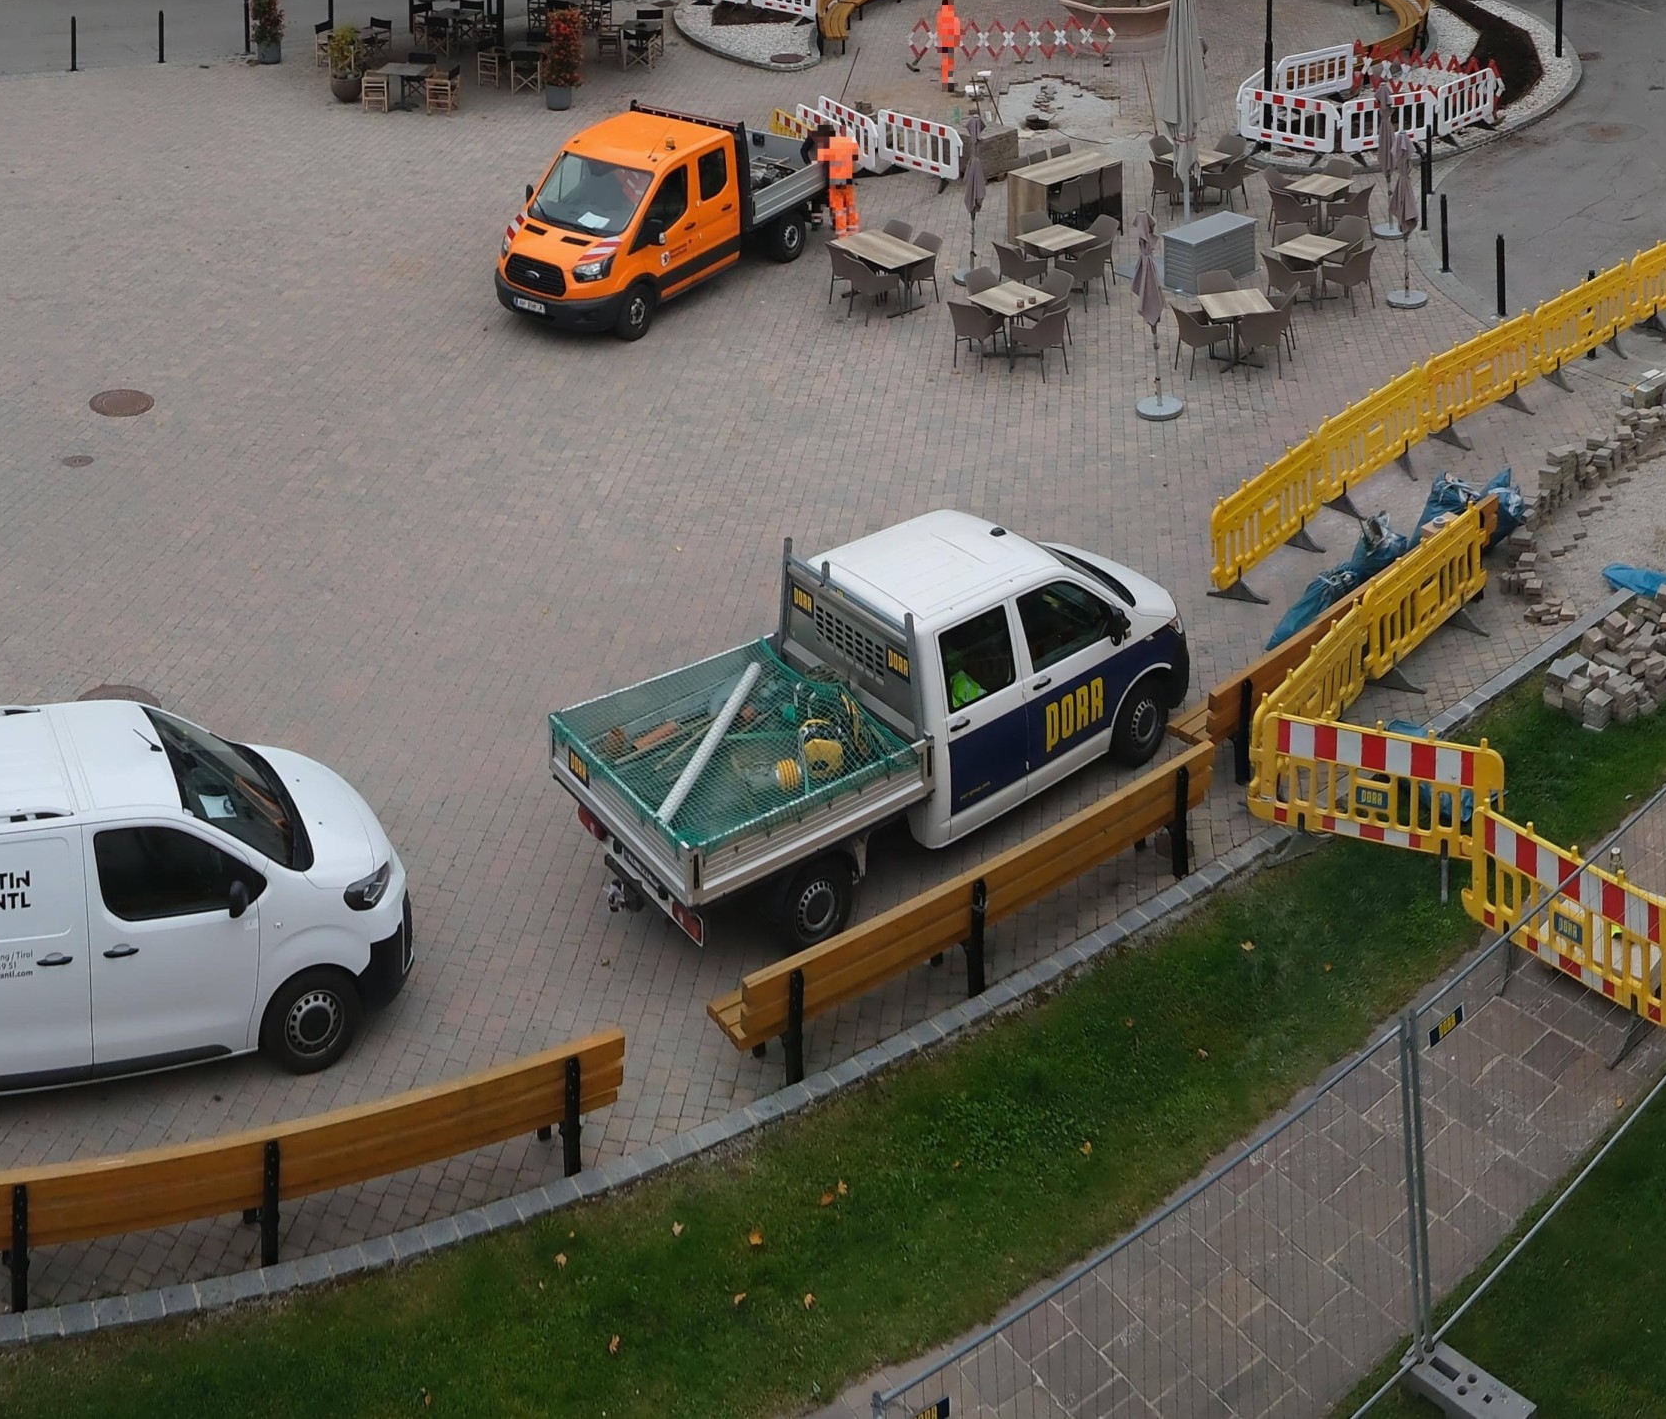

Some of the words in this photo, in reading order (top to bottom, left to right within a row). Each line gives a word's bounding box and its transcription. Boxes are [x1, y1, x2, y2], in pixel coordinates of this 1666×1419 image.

[793, 585, 813, 613] PORR
[888, 650, 909, 678] PORR
[1045, 677, 1104, 752] PORR
[1361, 788, 1383, 806] PORR
[1558, 916, 1579, 940] PORR
[16, 949, 34, 960] Tirol
